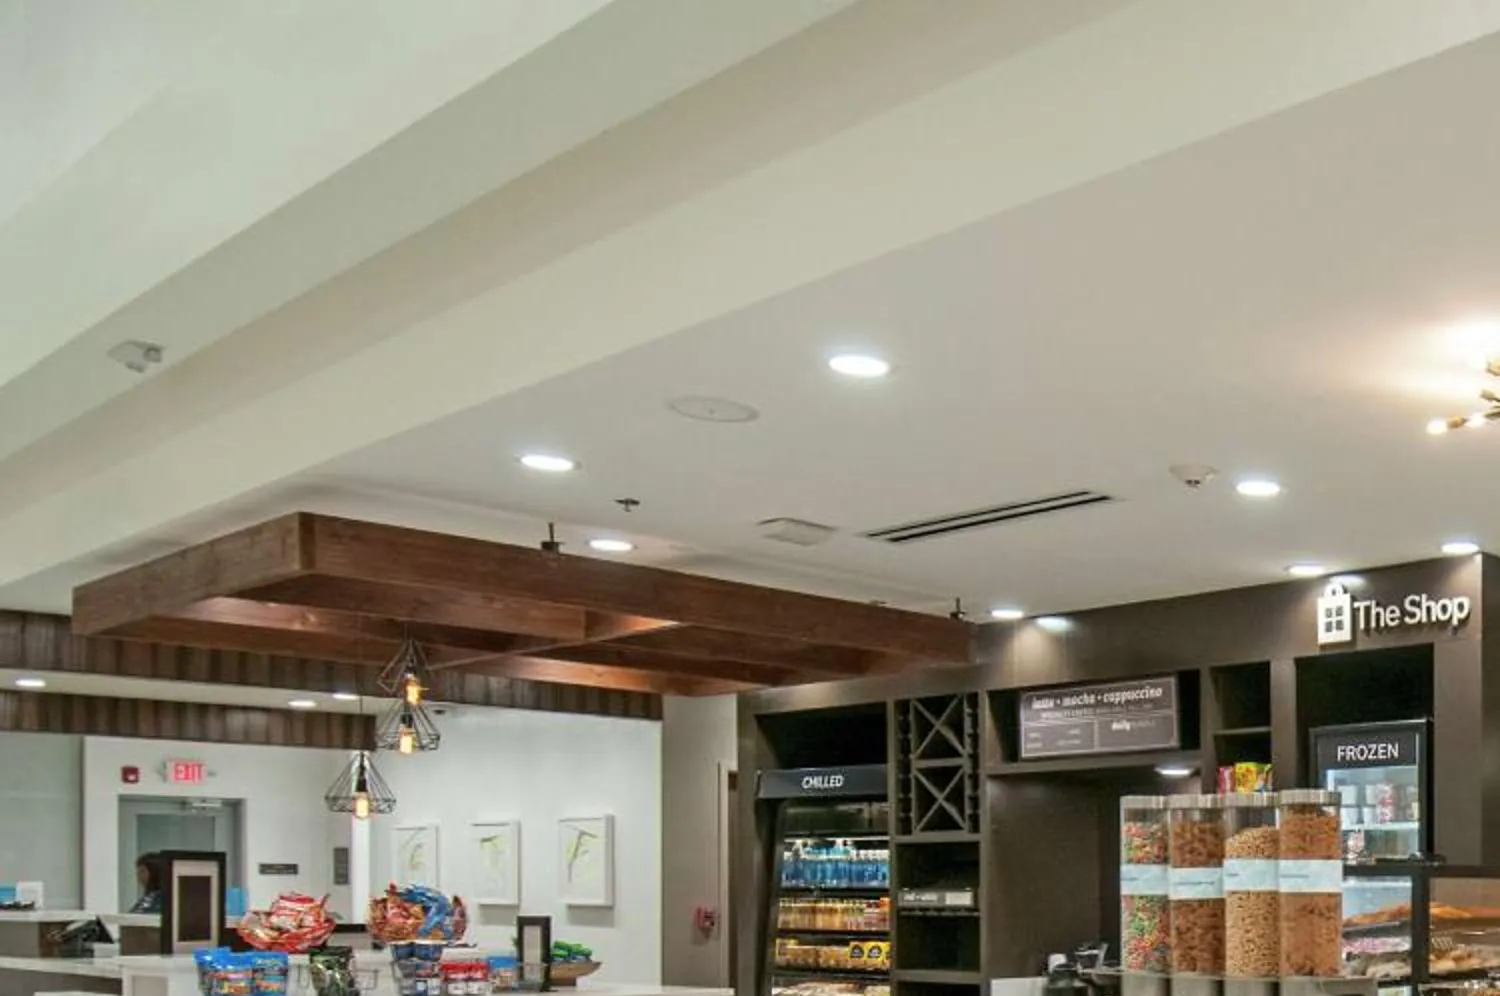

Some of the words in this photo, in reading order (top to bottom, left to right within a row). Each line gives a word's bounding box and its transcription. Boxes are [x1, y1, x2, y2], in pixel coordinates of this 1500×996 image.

[1354, 599, 1401, 631] The
[1403, 593, 1471, 627] Shop
[1103, 686, 1163, 704] cappuccino
[1337, 743, 1399, 762] FROZEN
[174, 762, 205, 782] EXIT
[801, 774, 845, 789] CHILLED
